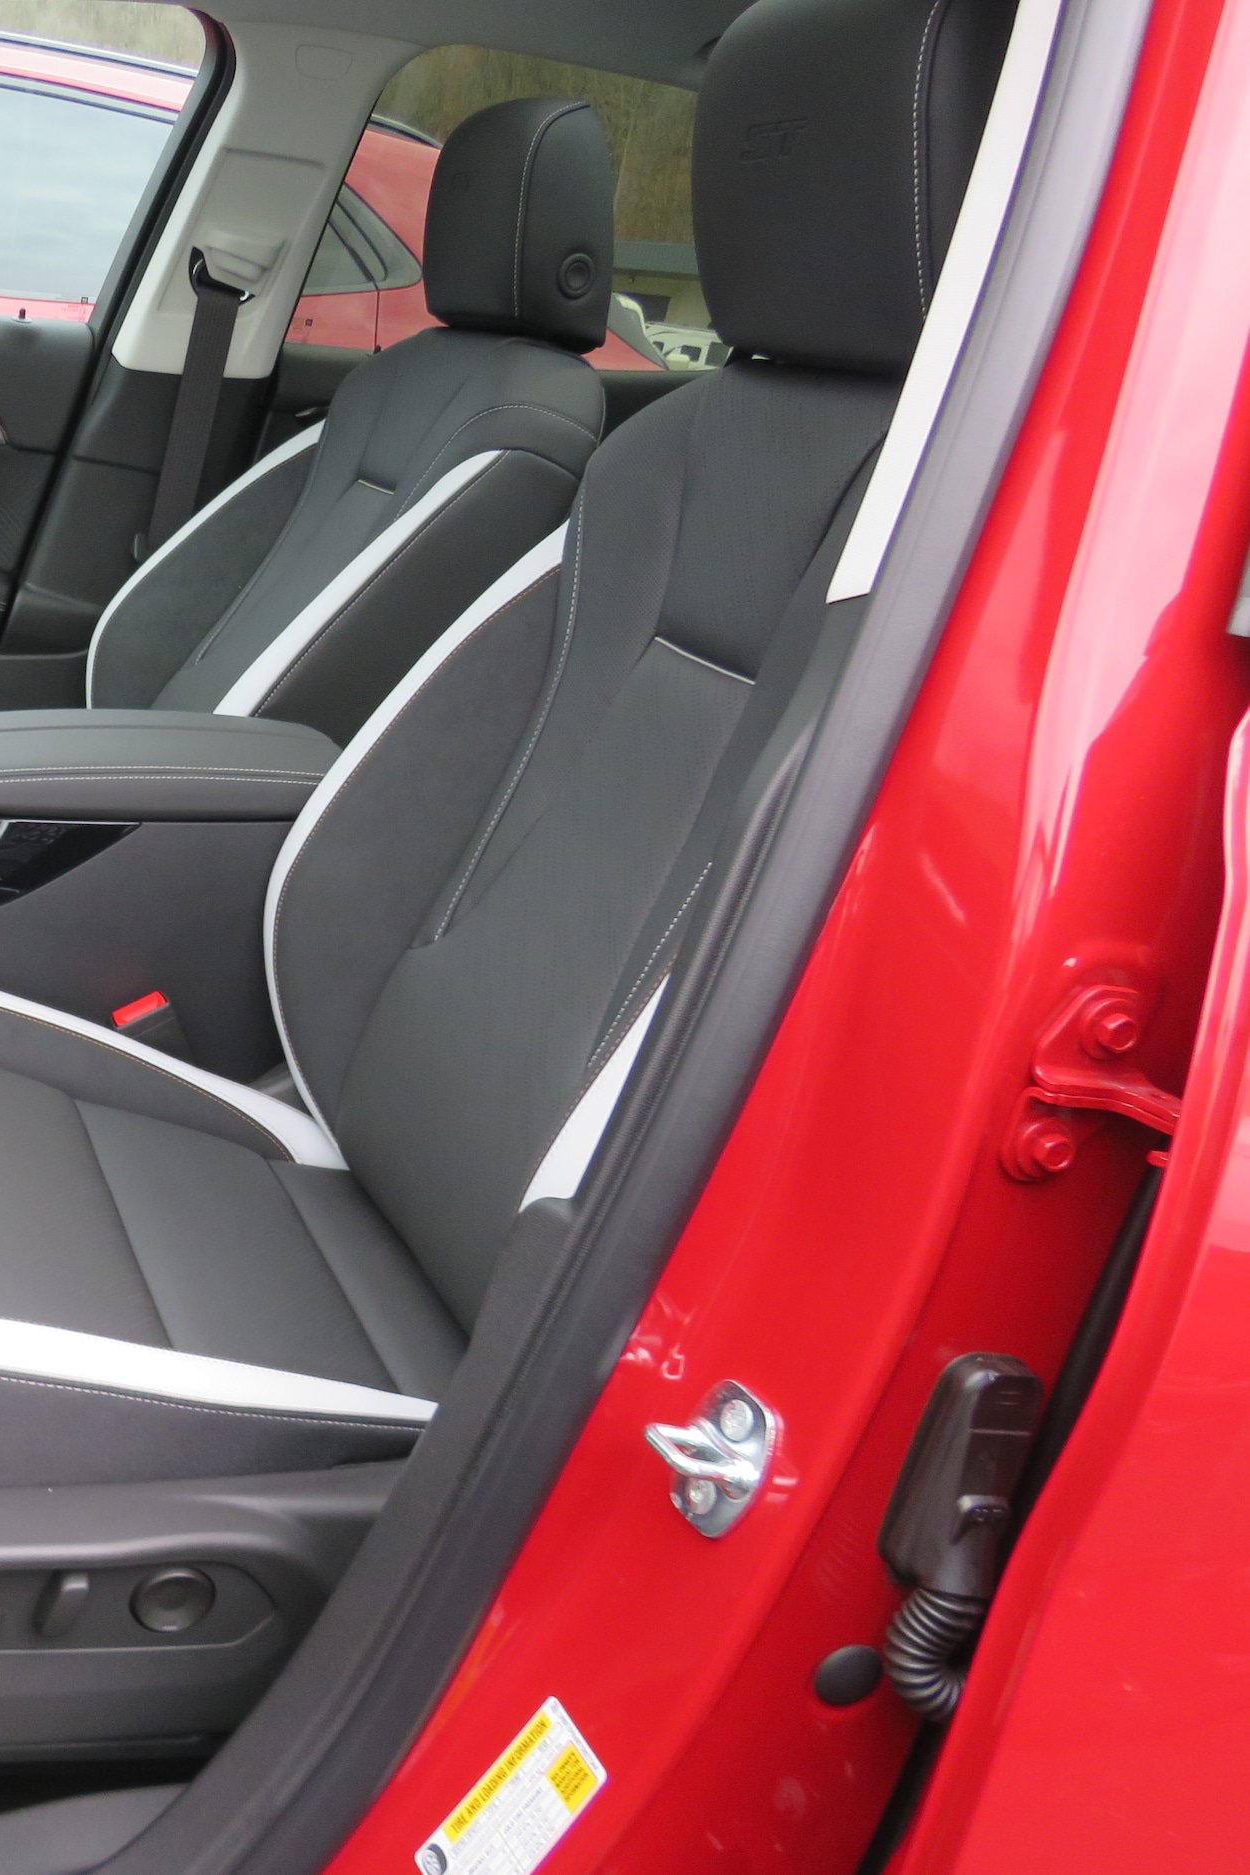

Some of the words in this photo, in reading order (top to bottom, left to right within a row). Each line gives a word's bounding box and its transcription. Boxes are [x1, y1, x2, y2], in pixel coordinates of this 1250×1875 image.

[740, 117, 810, 164] ST
[450, 1812, 469, 1834] TIRE
[464, 1796, 482, 1818] AND
[480, 1766, 508, 1802] LOADING
[505, 1718, 548, 1772] INFORMATION
